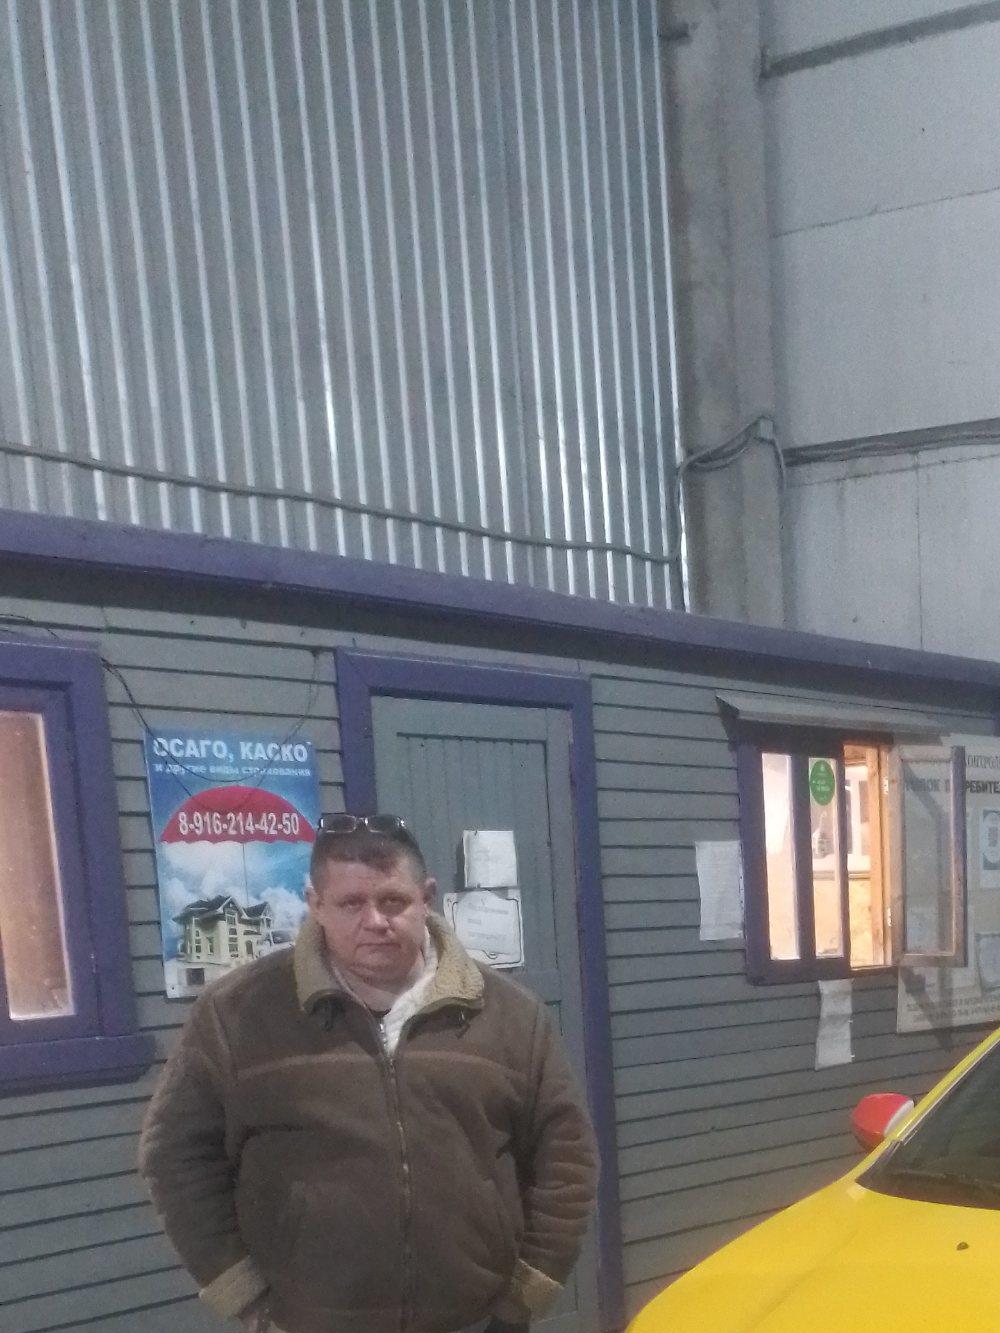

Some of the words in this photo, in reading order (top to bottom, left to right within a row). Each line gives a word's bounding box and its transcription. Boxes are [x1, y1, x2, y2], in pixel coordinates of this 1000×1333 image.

[153, 737, 234, 763] ОСАГО,
[240, 741, 308, 763] КАСКО
[178, 811, 300, 836] 8-916-214-42-50
